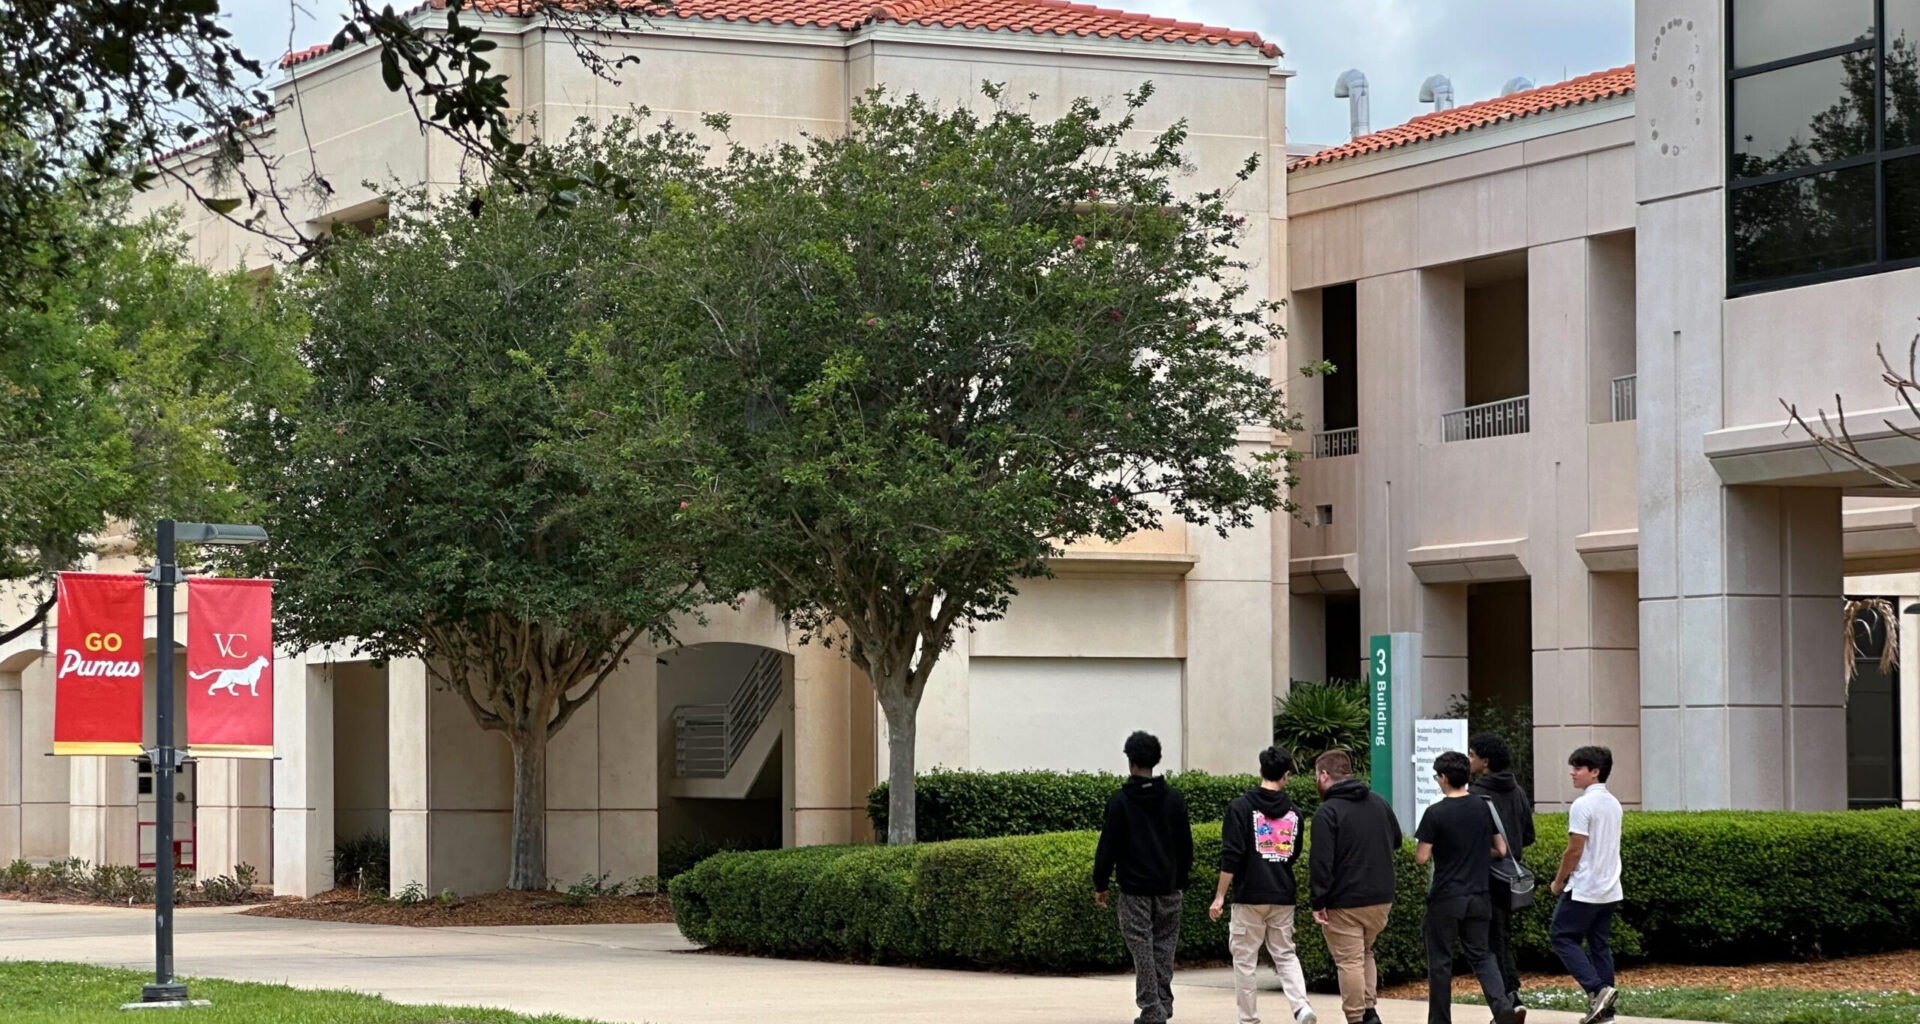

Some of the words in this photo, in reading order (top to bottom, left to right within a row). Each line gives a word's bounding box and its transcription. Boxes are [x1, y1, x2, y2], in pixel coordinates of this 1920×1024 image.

[85, 632, 122, 652] GO
[213, 633, 248, 658] VC
[58, 649, 140, 678] Pumas
[1376, 649, 1386, 675] 3
[1376, 681, 1386, 745] Building
[1416, 776, 1430, 784] Nursing
[1423, 788, 1438, 796] Learning
